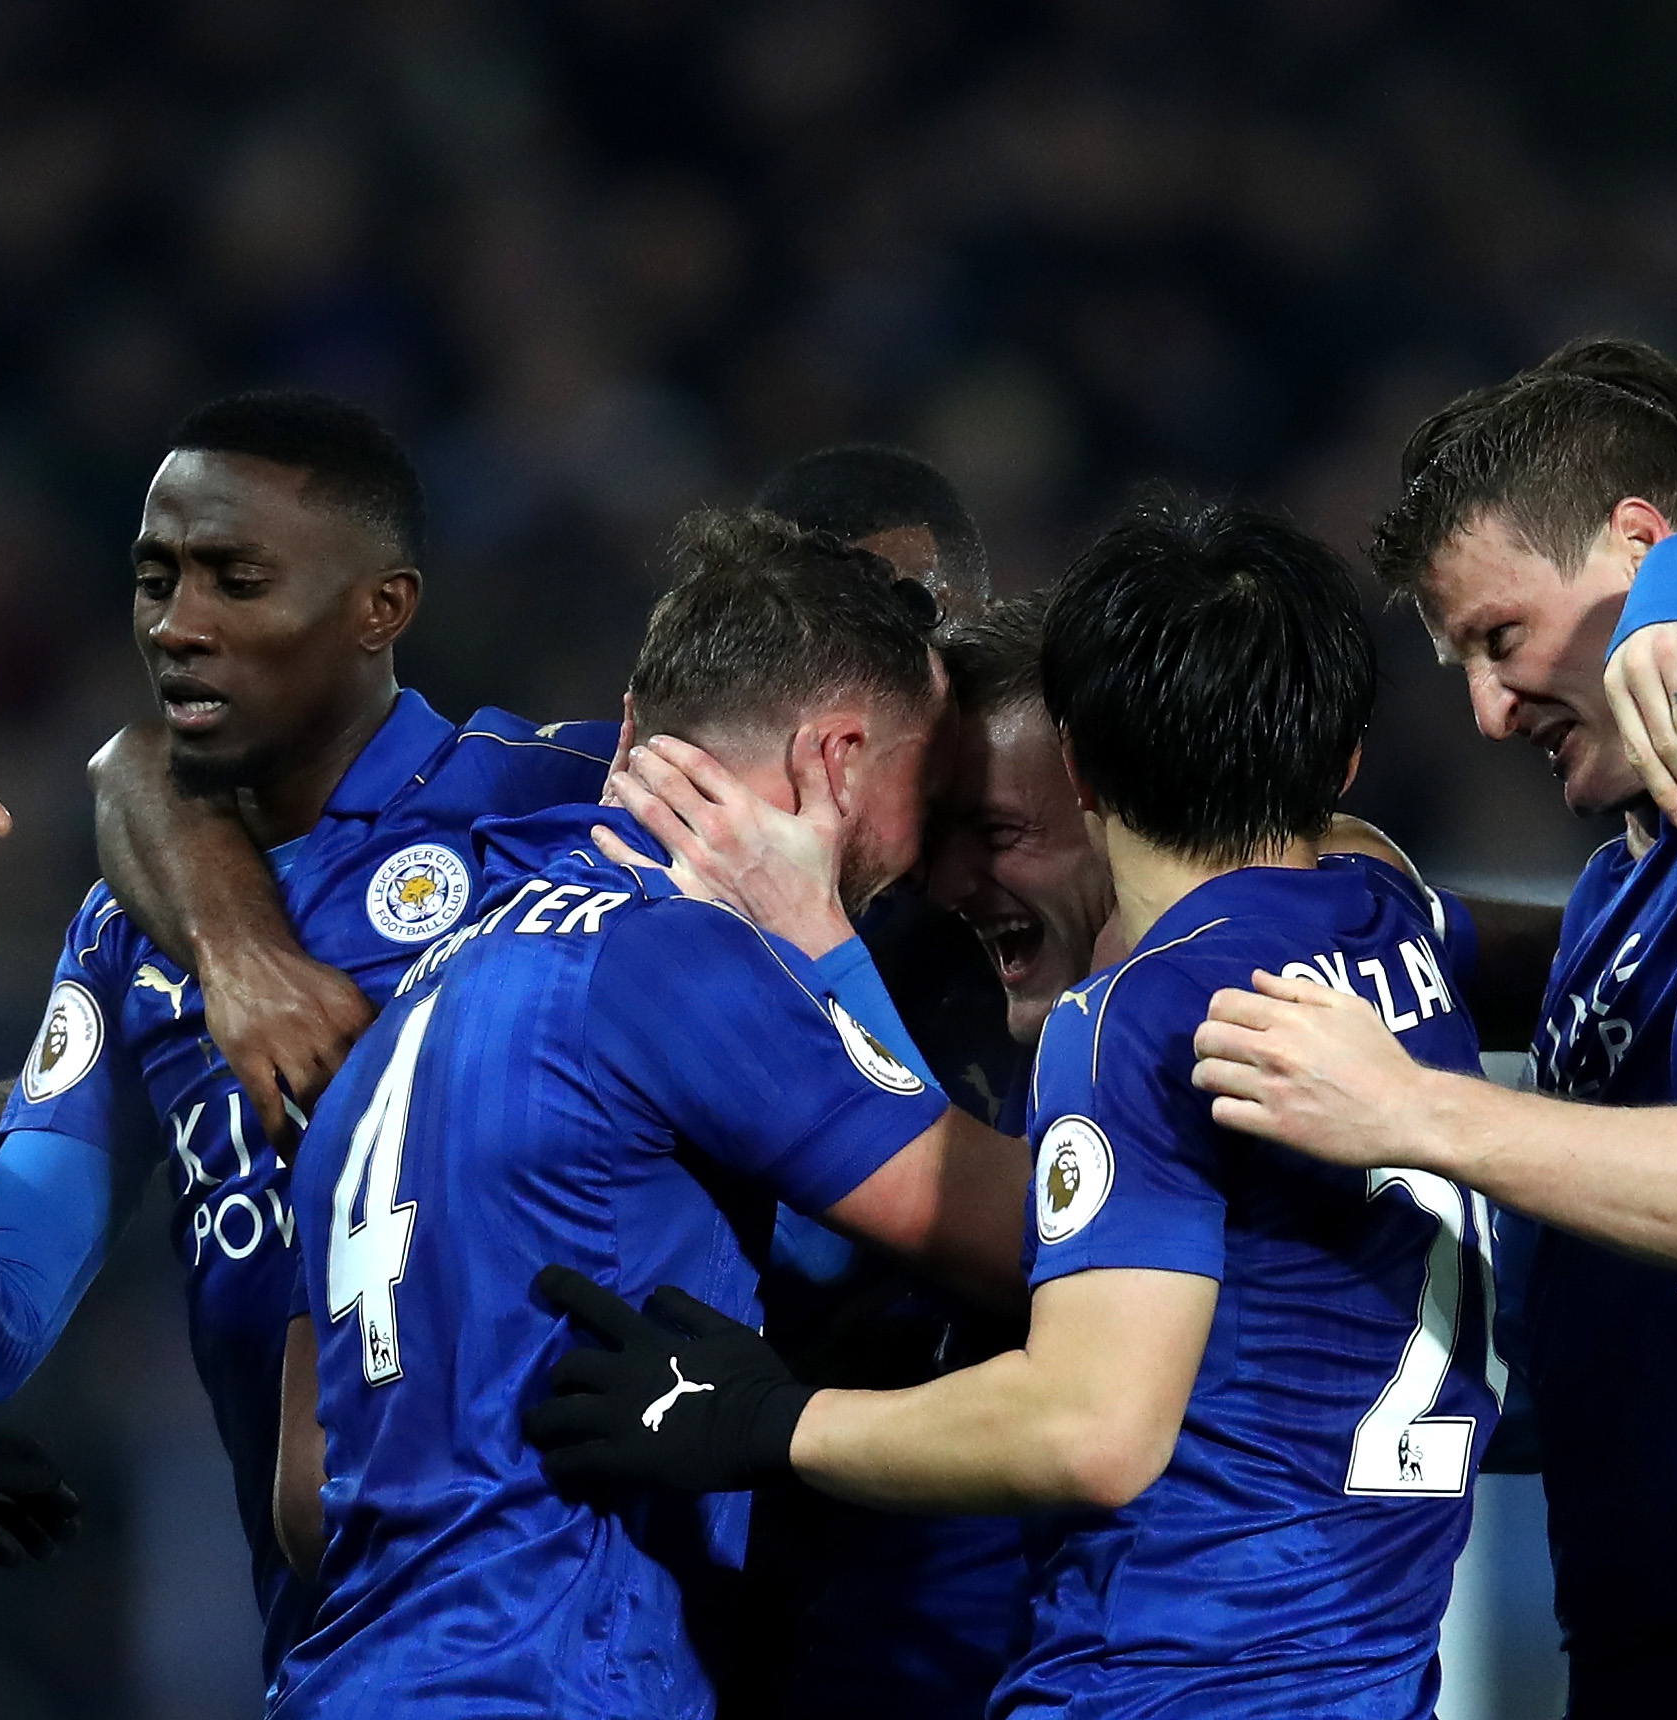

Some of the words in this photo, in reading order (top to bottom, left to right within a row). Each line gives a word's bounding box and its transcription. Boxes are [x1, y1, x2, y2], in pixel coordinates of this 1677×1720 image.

[374, 850, 433, 903] LEICESTER
[435, 853, 461, 876] CITY
[375, 909, 444, 936] FOOTBALL
[442, 883, 463, 920] CLUB
[325, 990, 441, 1388] 4
